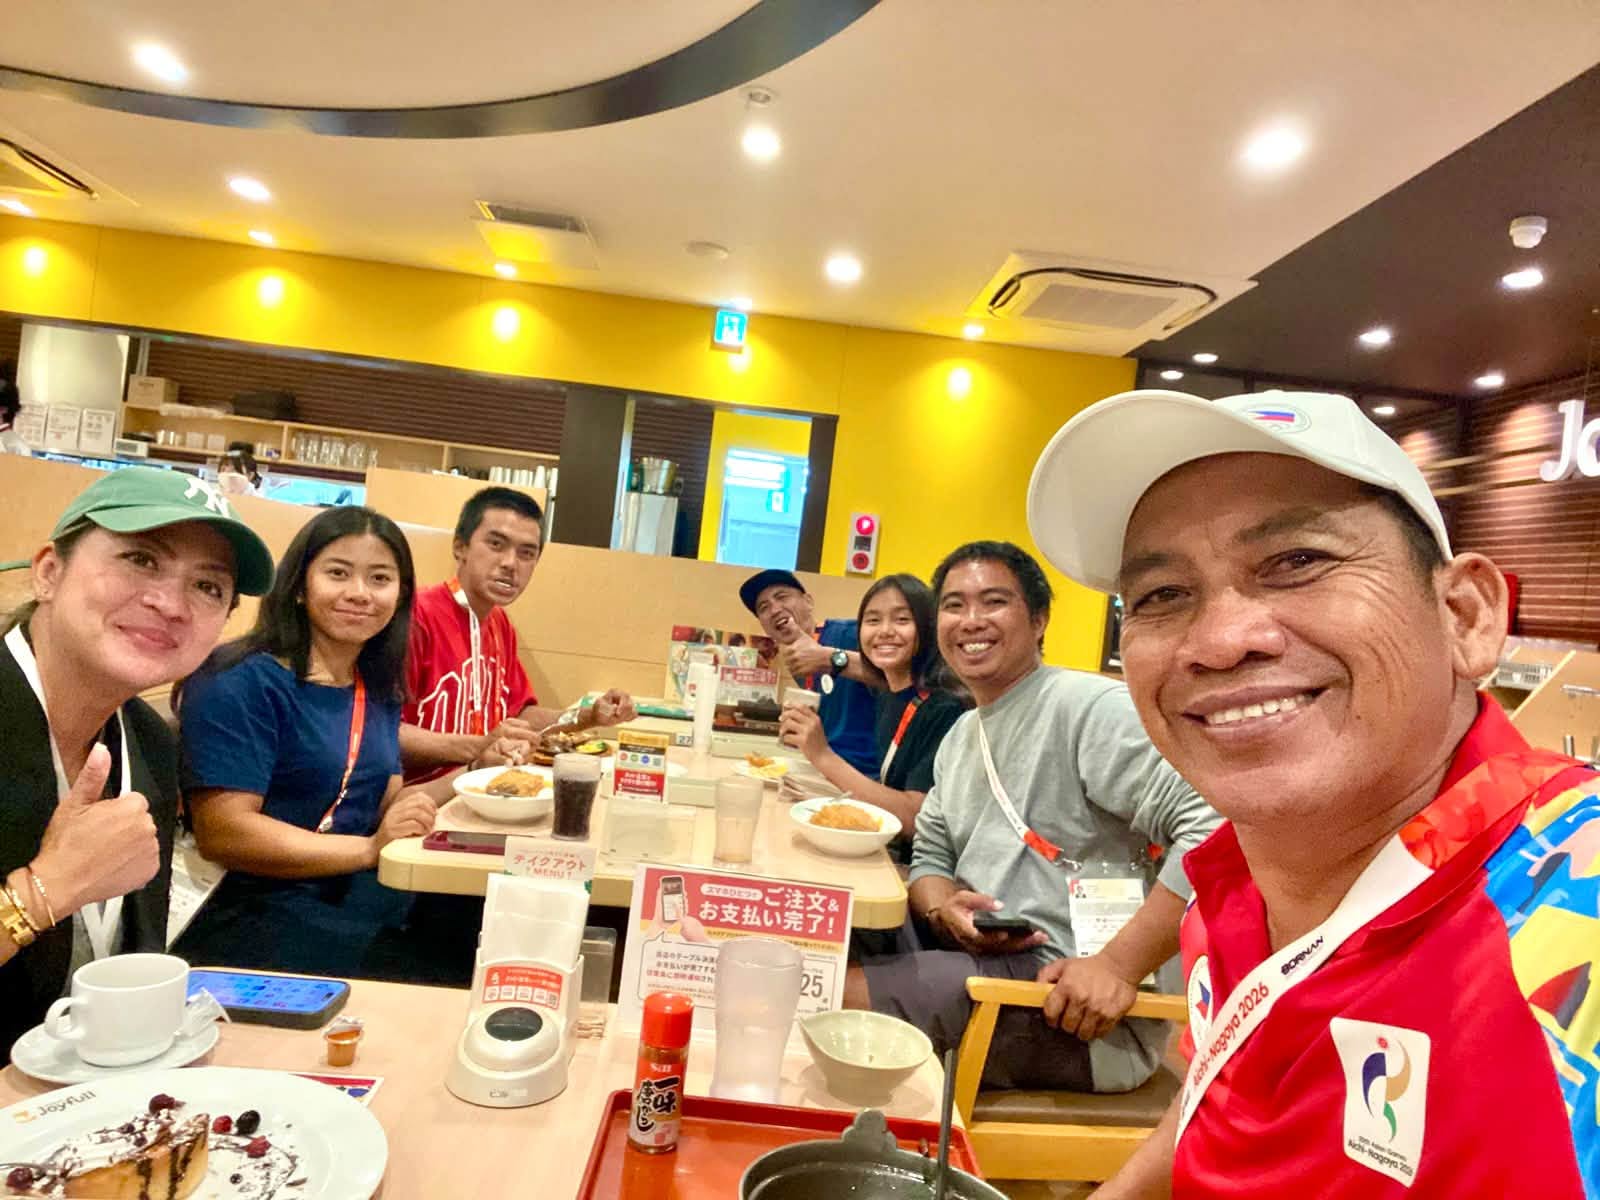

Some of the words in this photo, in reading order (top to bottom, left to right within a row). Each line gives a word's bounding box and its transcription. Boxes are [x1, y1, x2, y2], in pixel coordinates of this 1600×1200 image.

[514, 854, 586, 872] テイクアウト
[764, 886, 839, 913] ご注文&
[698, 901, 835, 934] お支払い完了!
[1281, 936, 1324, 975] BORNAN
[799, 973, 823, 998] 25
[1238, 981, 1270, 1019] 2026
[39, 1090, 97, 1116] Joyfull
[653, 1077, 680, 1113] 一味
